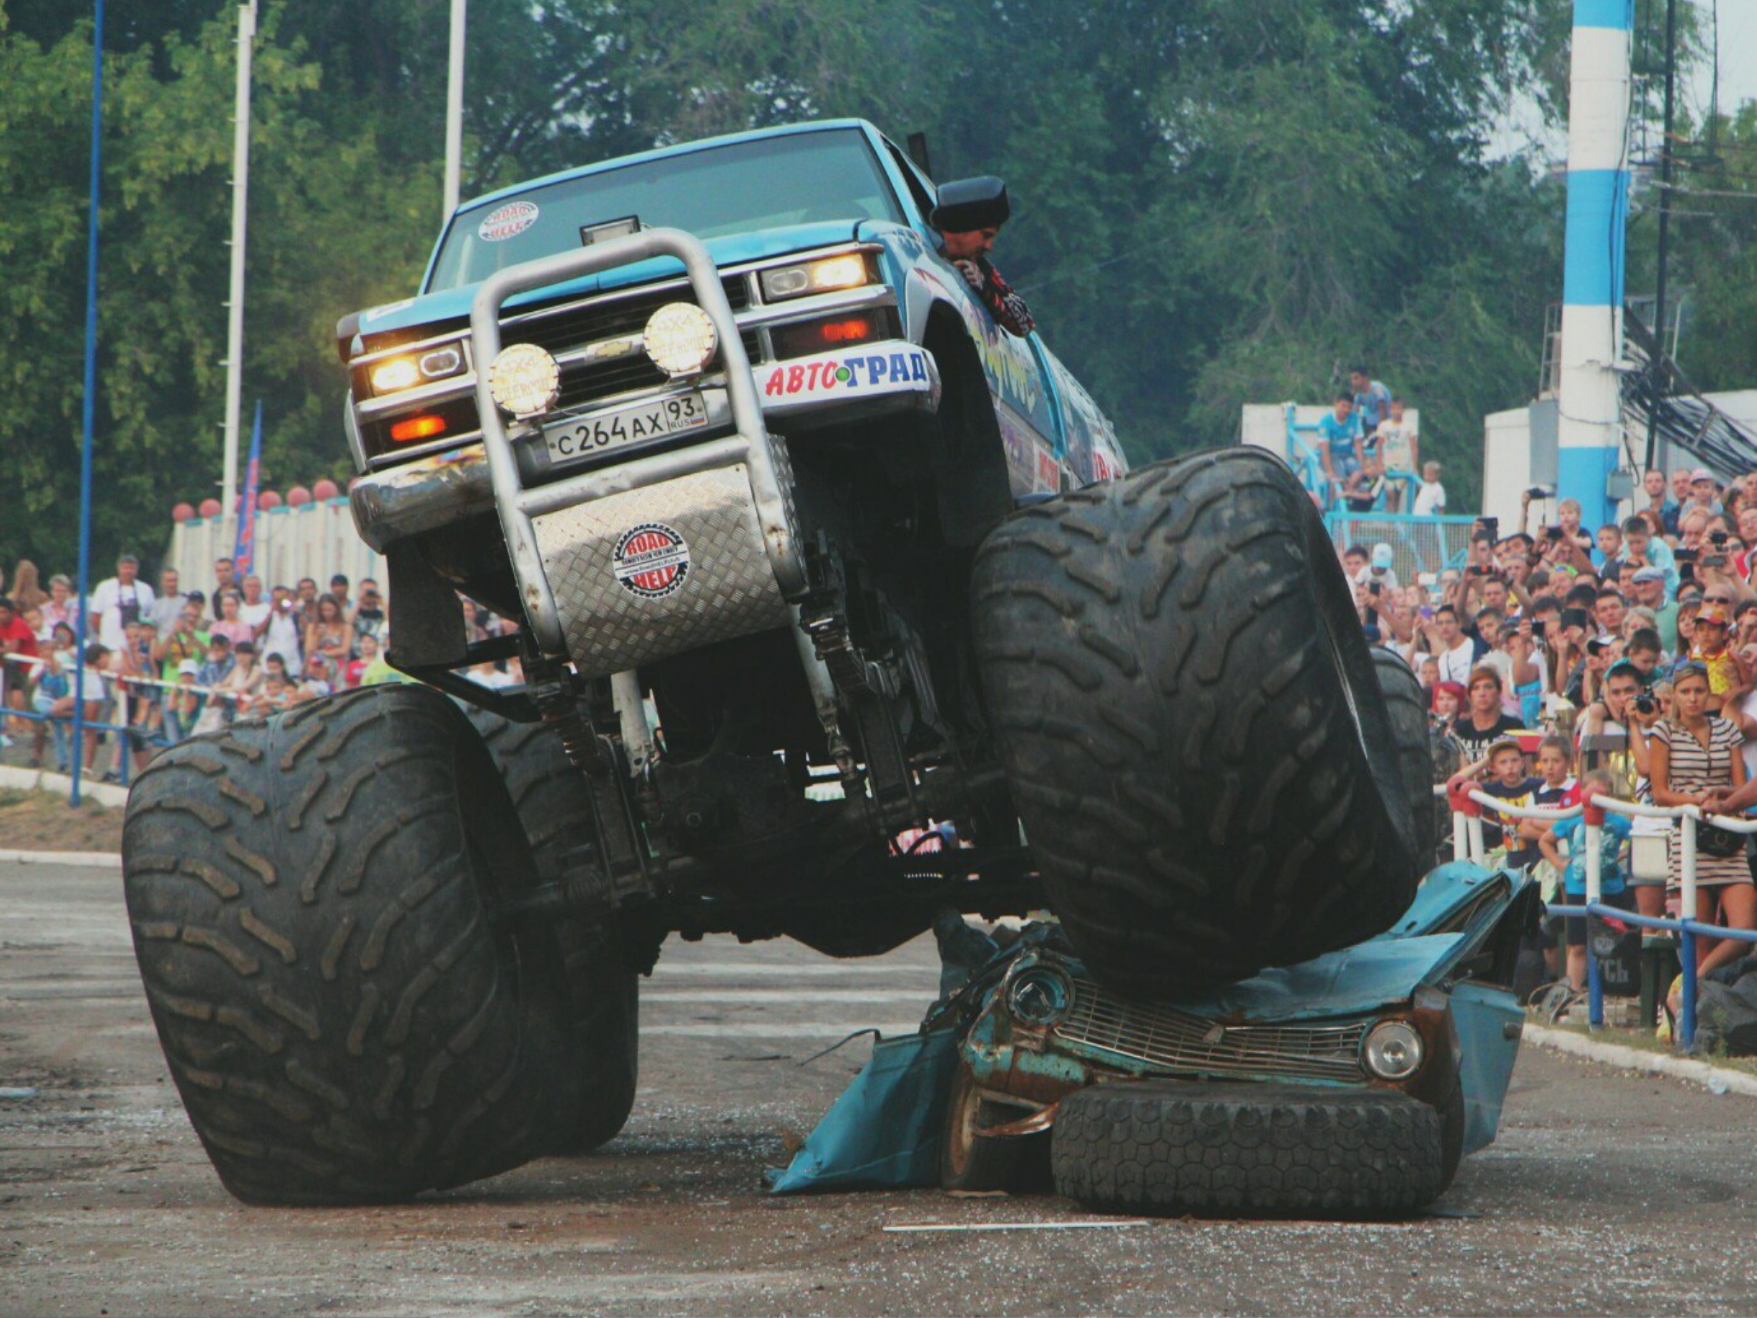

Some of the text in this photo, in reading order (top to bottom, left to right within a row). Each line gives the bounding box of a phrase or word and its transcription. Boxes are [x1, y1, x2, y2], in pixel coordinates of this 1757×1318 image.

[558, 397, 695, 455] С264АХ 93
[670, 420, 691, 430] RUS
[626, 533, 669, 556] ROAD
[633, 565, 676, 589] HELP
